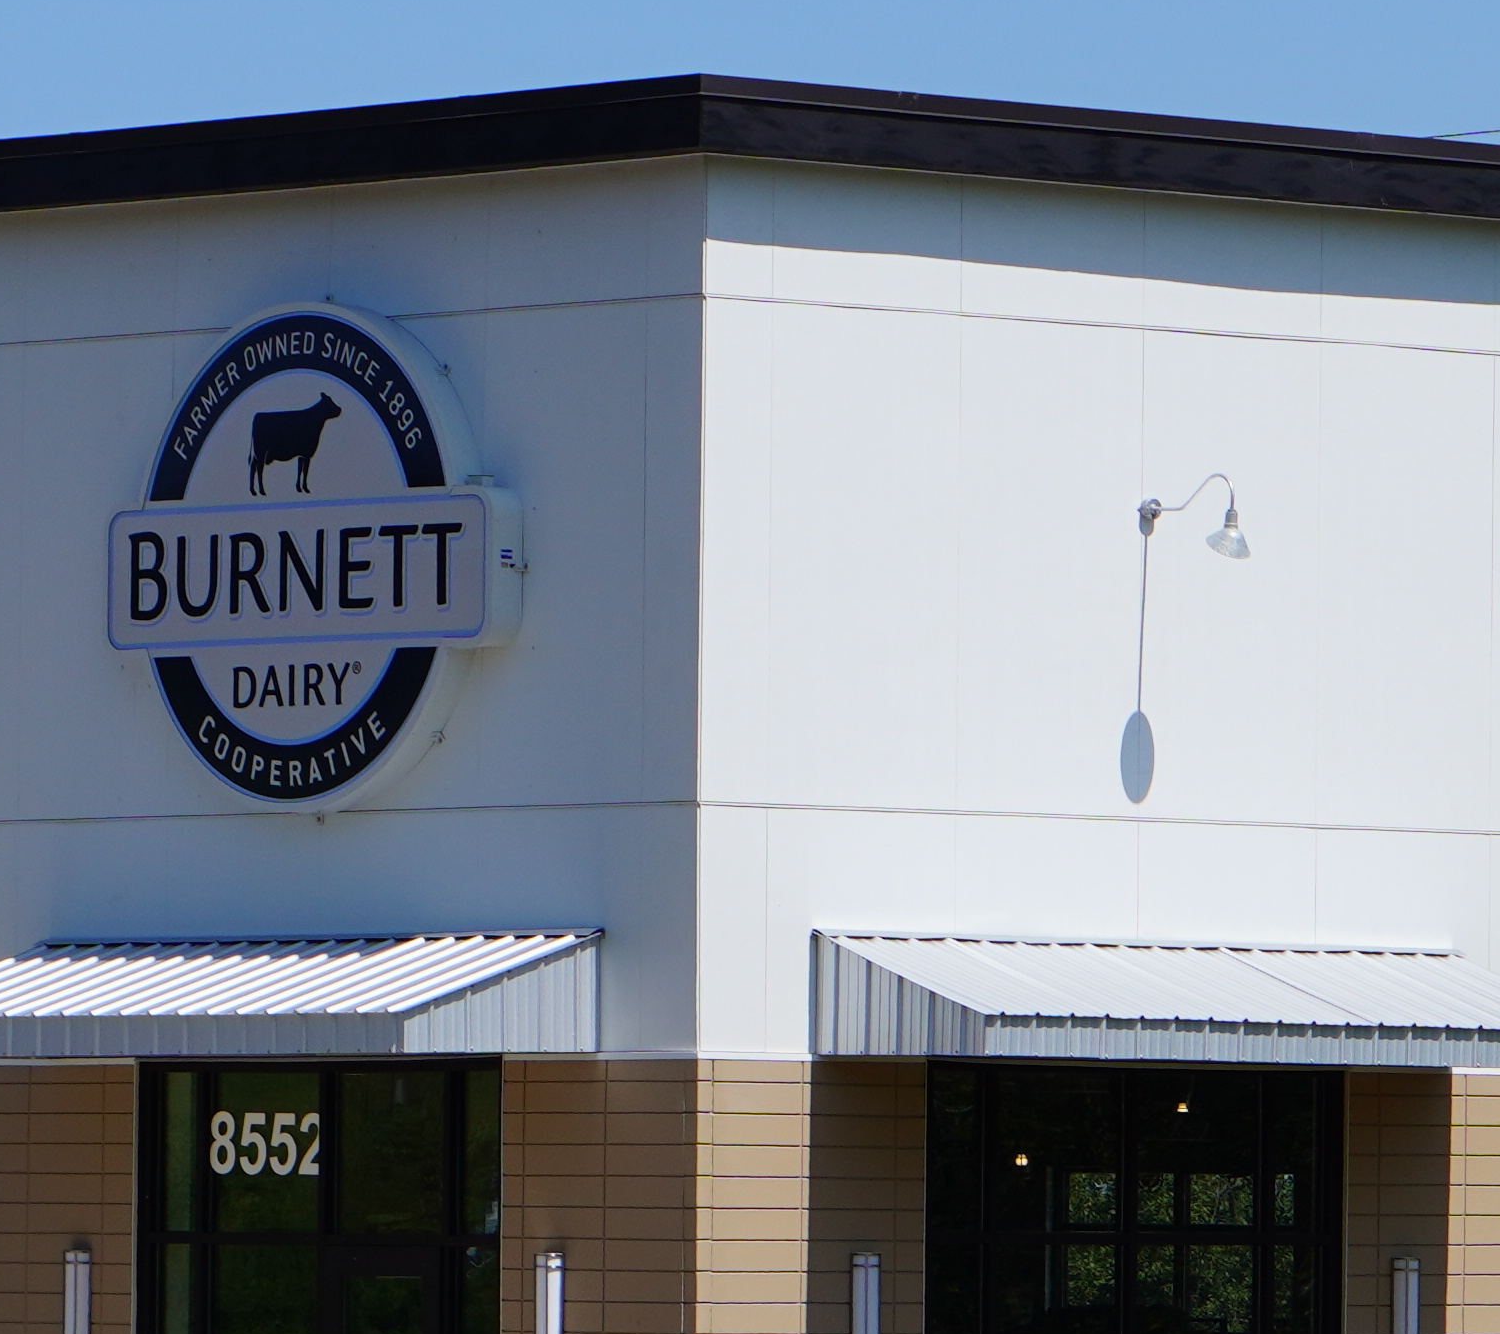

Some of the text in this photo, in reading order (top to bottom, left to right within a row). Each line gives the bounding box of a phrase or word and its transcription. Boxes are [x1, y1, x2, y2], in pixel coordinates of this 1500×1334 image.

[173, 331, 422, 461] FARMER OWNED SINCE 1896
[128, 522, 464, 622] BURNETT
[199, 710, 386, 787] COOPERATIVE
[209, 1110, 320, 1176] 8552
